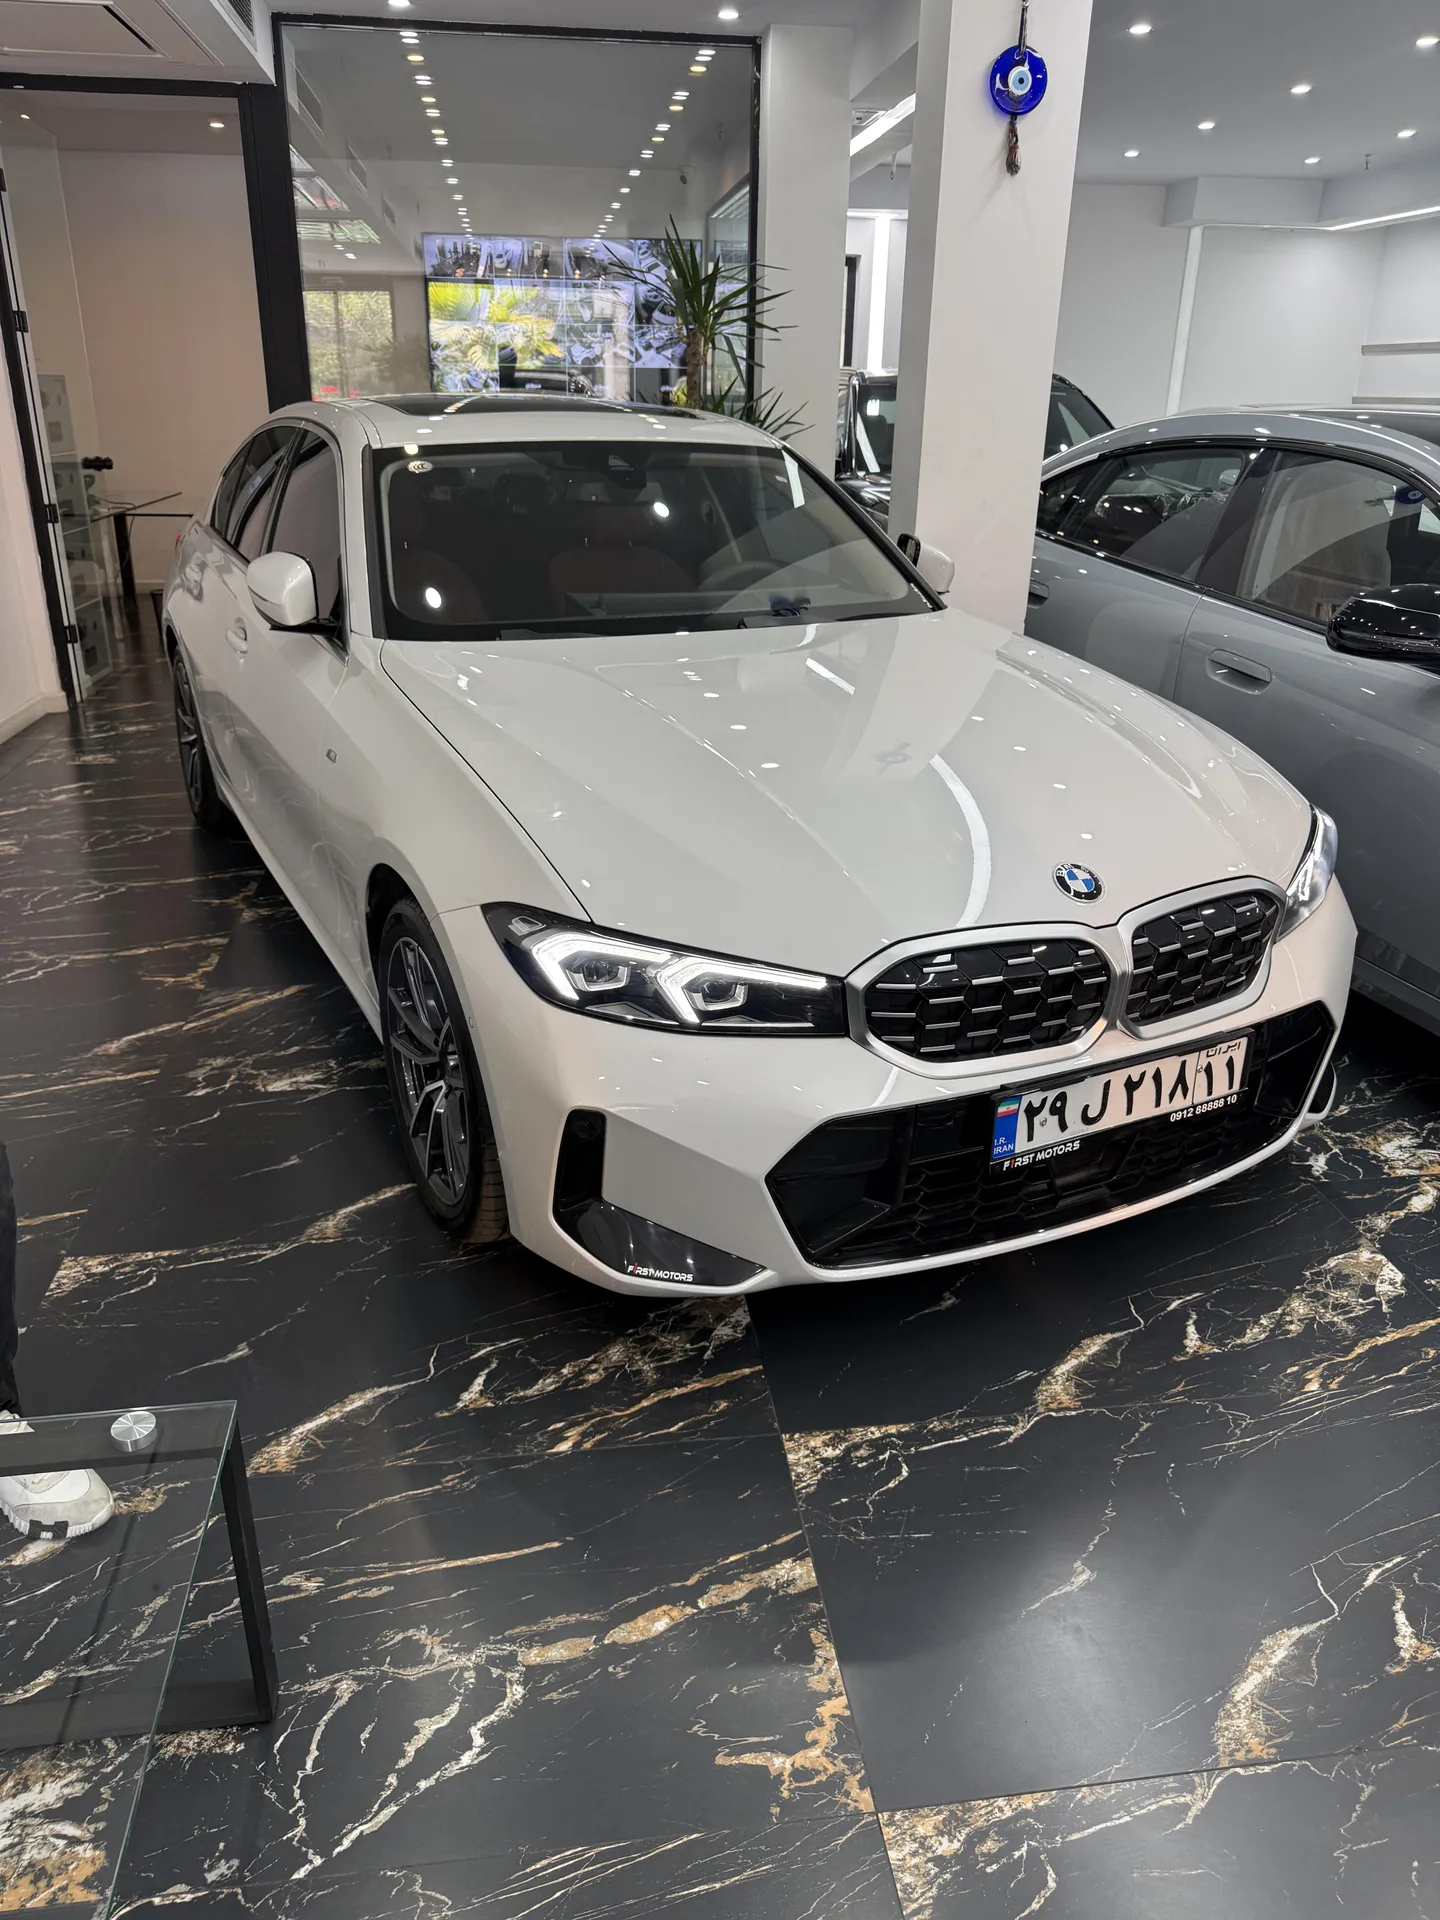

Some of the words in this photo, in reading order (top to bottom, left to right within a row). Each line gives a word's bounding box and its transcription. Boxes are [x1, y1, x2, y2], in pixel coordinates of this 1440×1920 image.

[1205, 1041, 1241, 1058] ایران
[1023, 1091, 1068, 1143] ۲۹
[1123, 1059, 1189, 1116] ۲۱۸
[1204, 1055, 1235, 1097] ۱۱
[1170, 1108, 1194, 1122] 0912
[1195, 1098, 1224, 1114] 88888
[1226, 1094, 1237, 1105] 10
[993, 1143, 1014, 1155] IRAN
[994, 1137, 1007, 1146] I.R.
[1035, 1140, 1081, 1161] MOTORS
[654, 1269, 693, 1282] MOTORS
